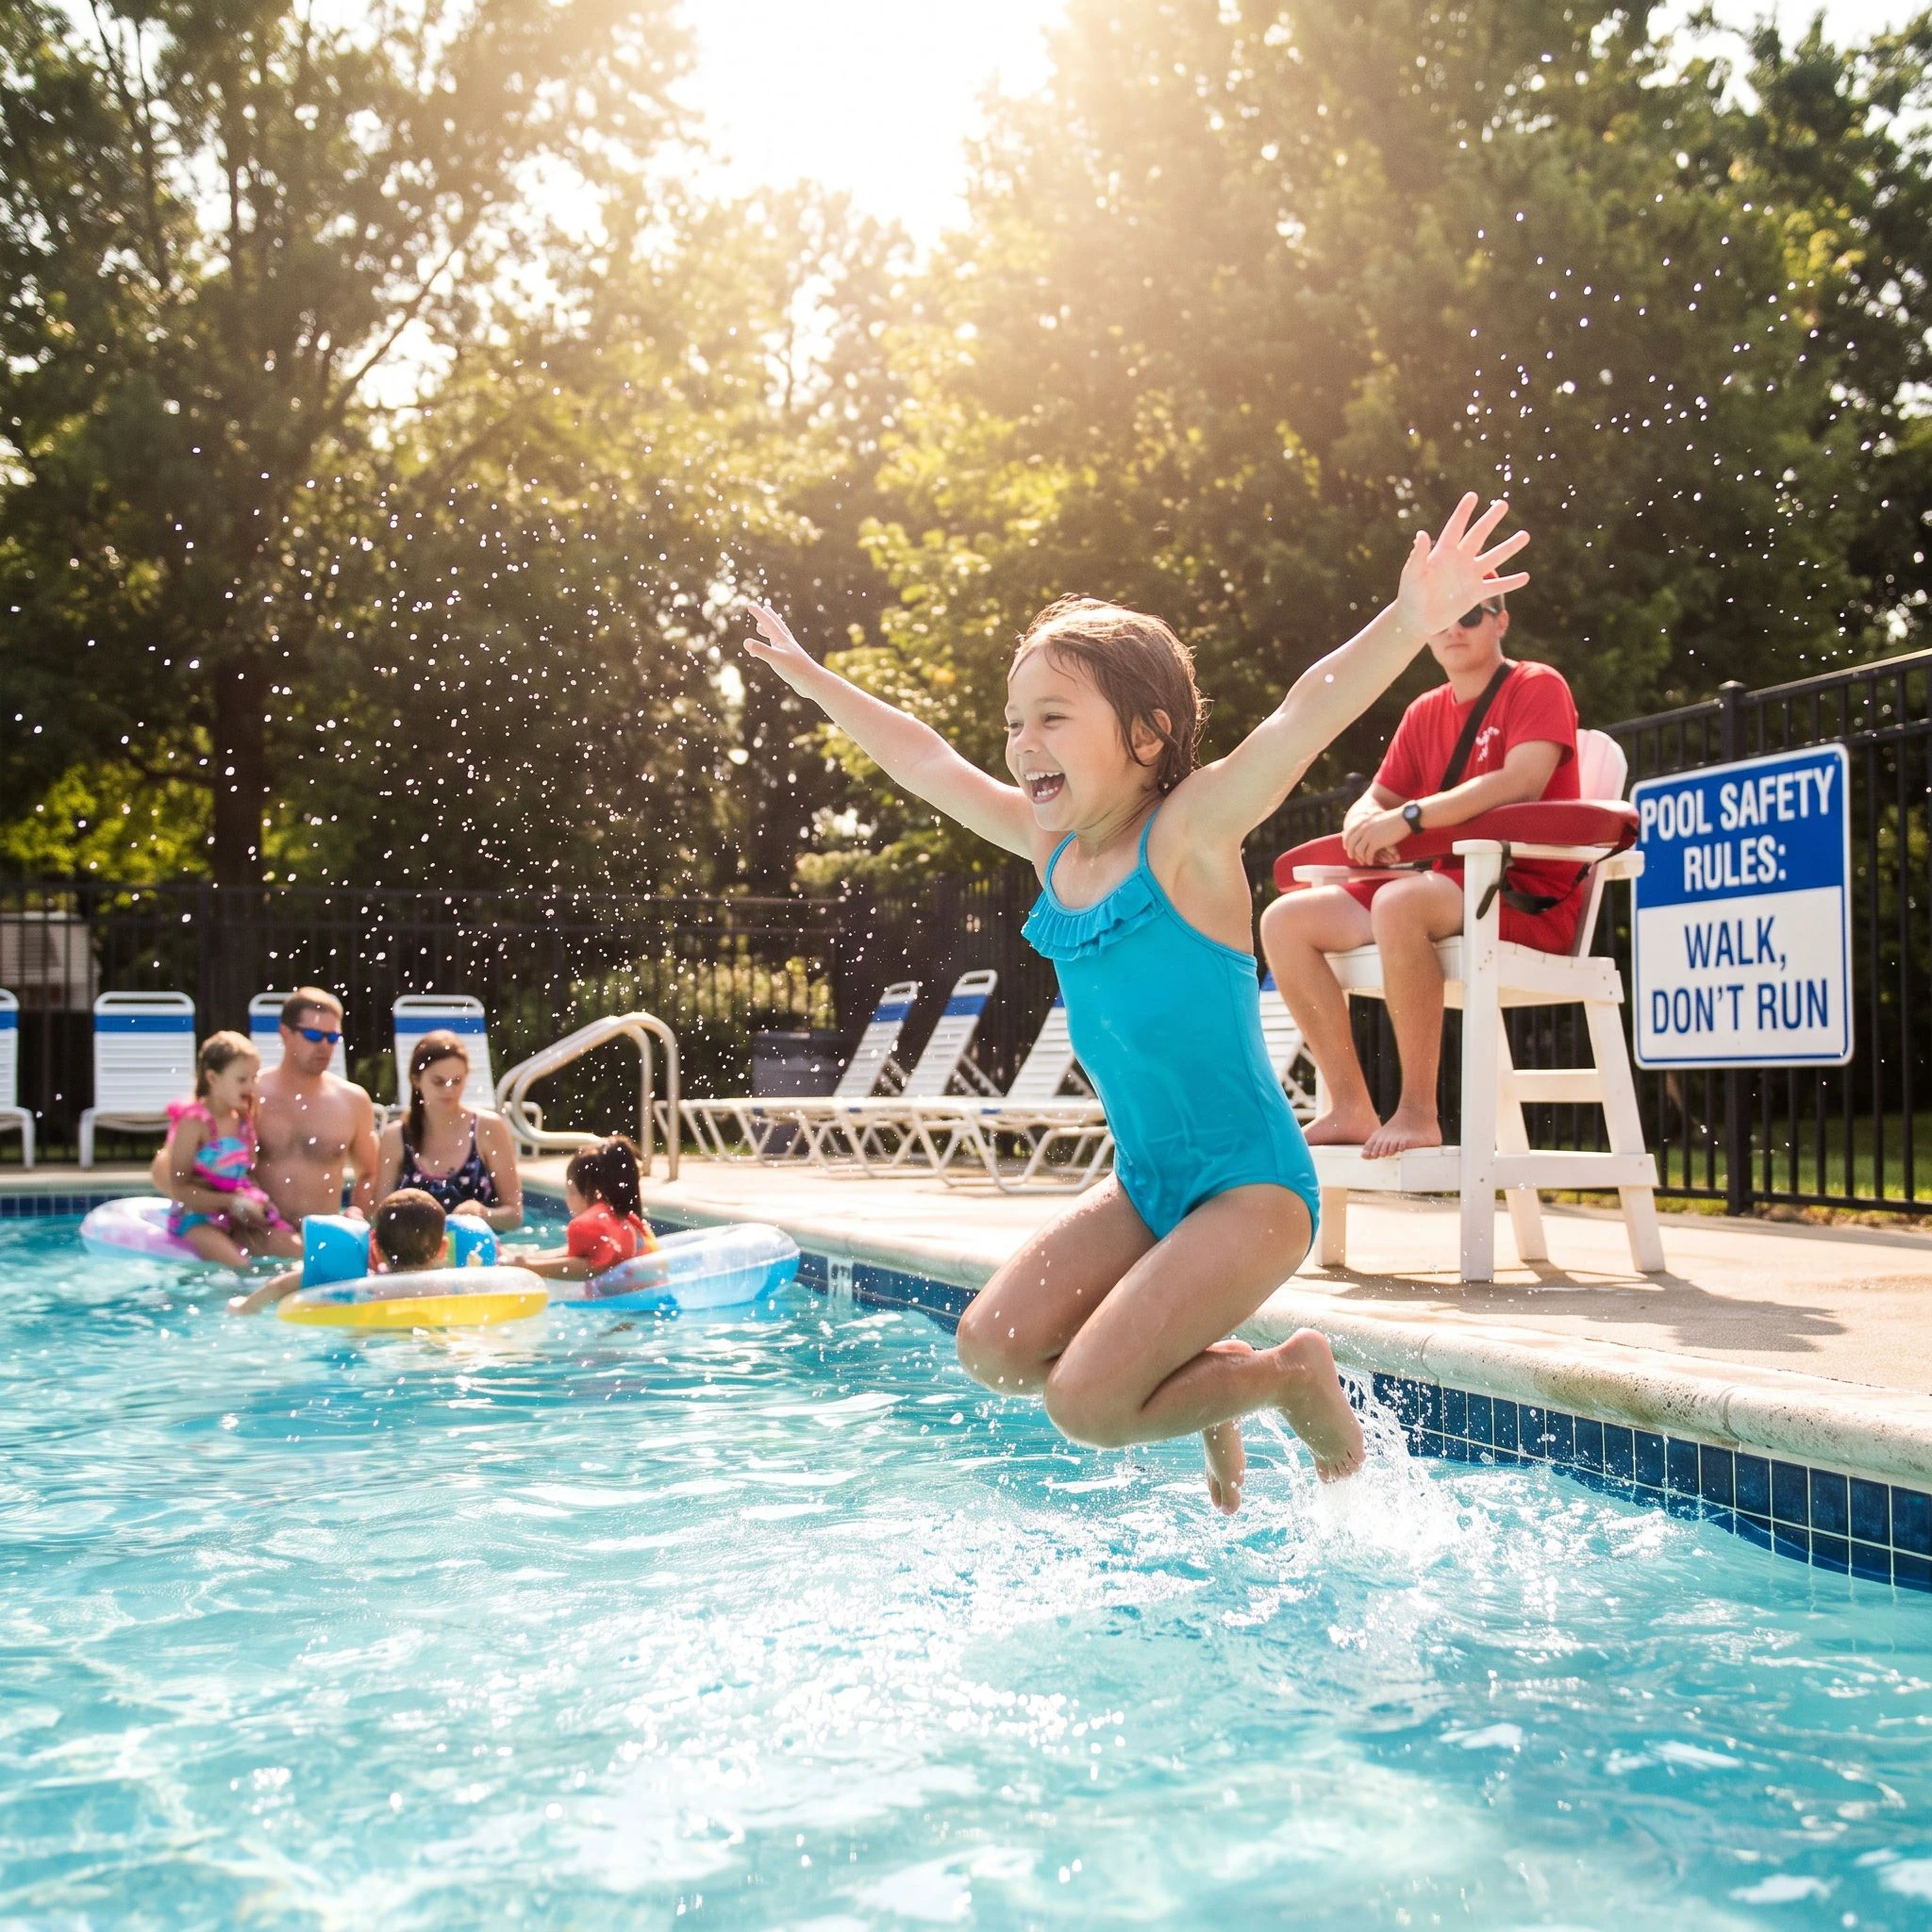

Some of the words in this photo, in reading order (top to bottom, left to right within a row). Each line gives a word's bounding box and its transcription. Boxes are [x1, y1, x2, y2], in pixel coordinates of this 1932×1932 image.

[1640, 789, 1713, 843] POOL
[1720, 765, 1835, 831] SAFETY
[1684, 834, 1787, 891] RULES:
[1684, 915, 1786, 971] WALK,
[1652, 984, 1744, 1034] DON'T
[1757, 977, 1828, 1030] RUN
